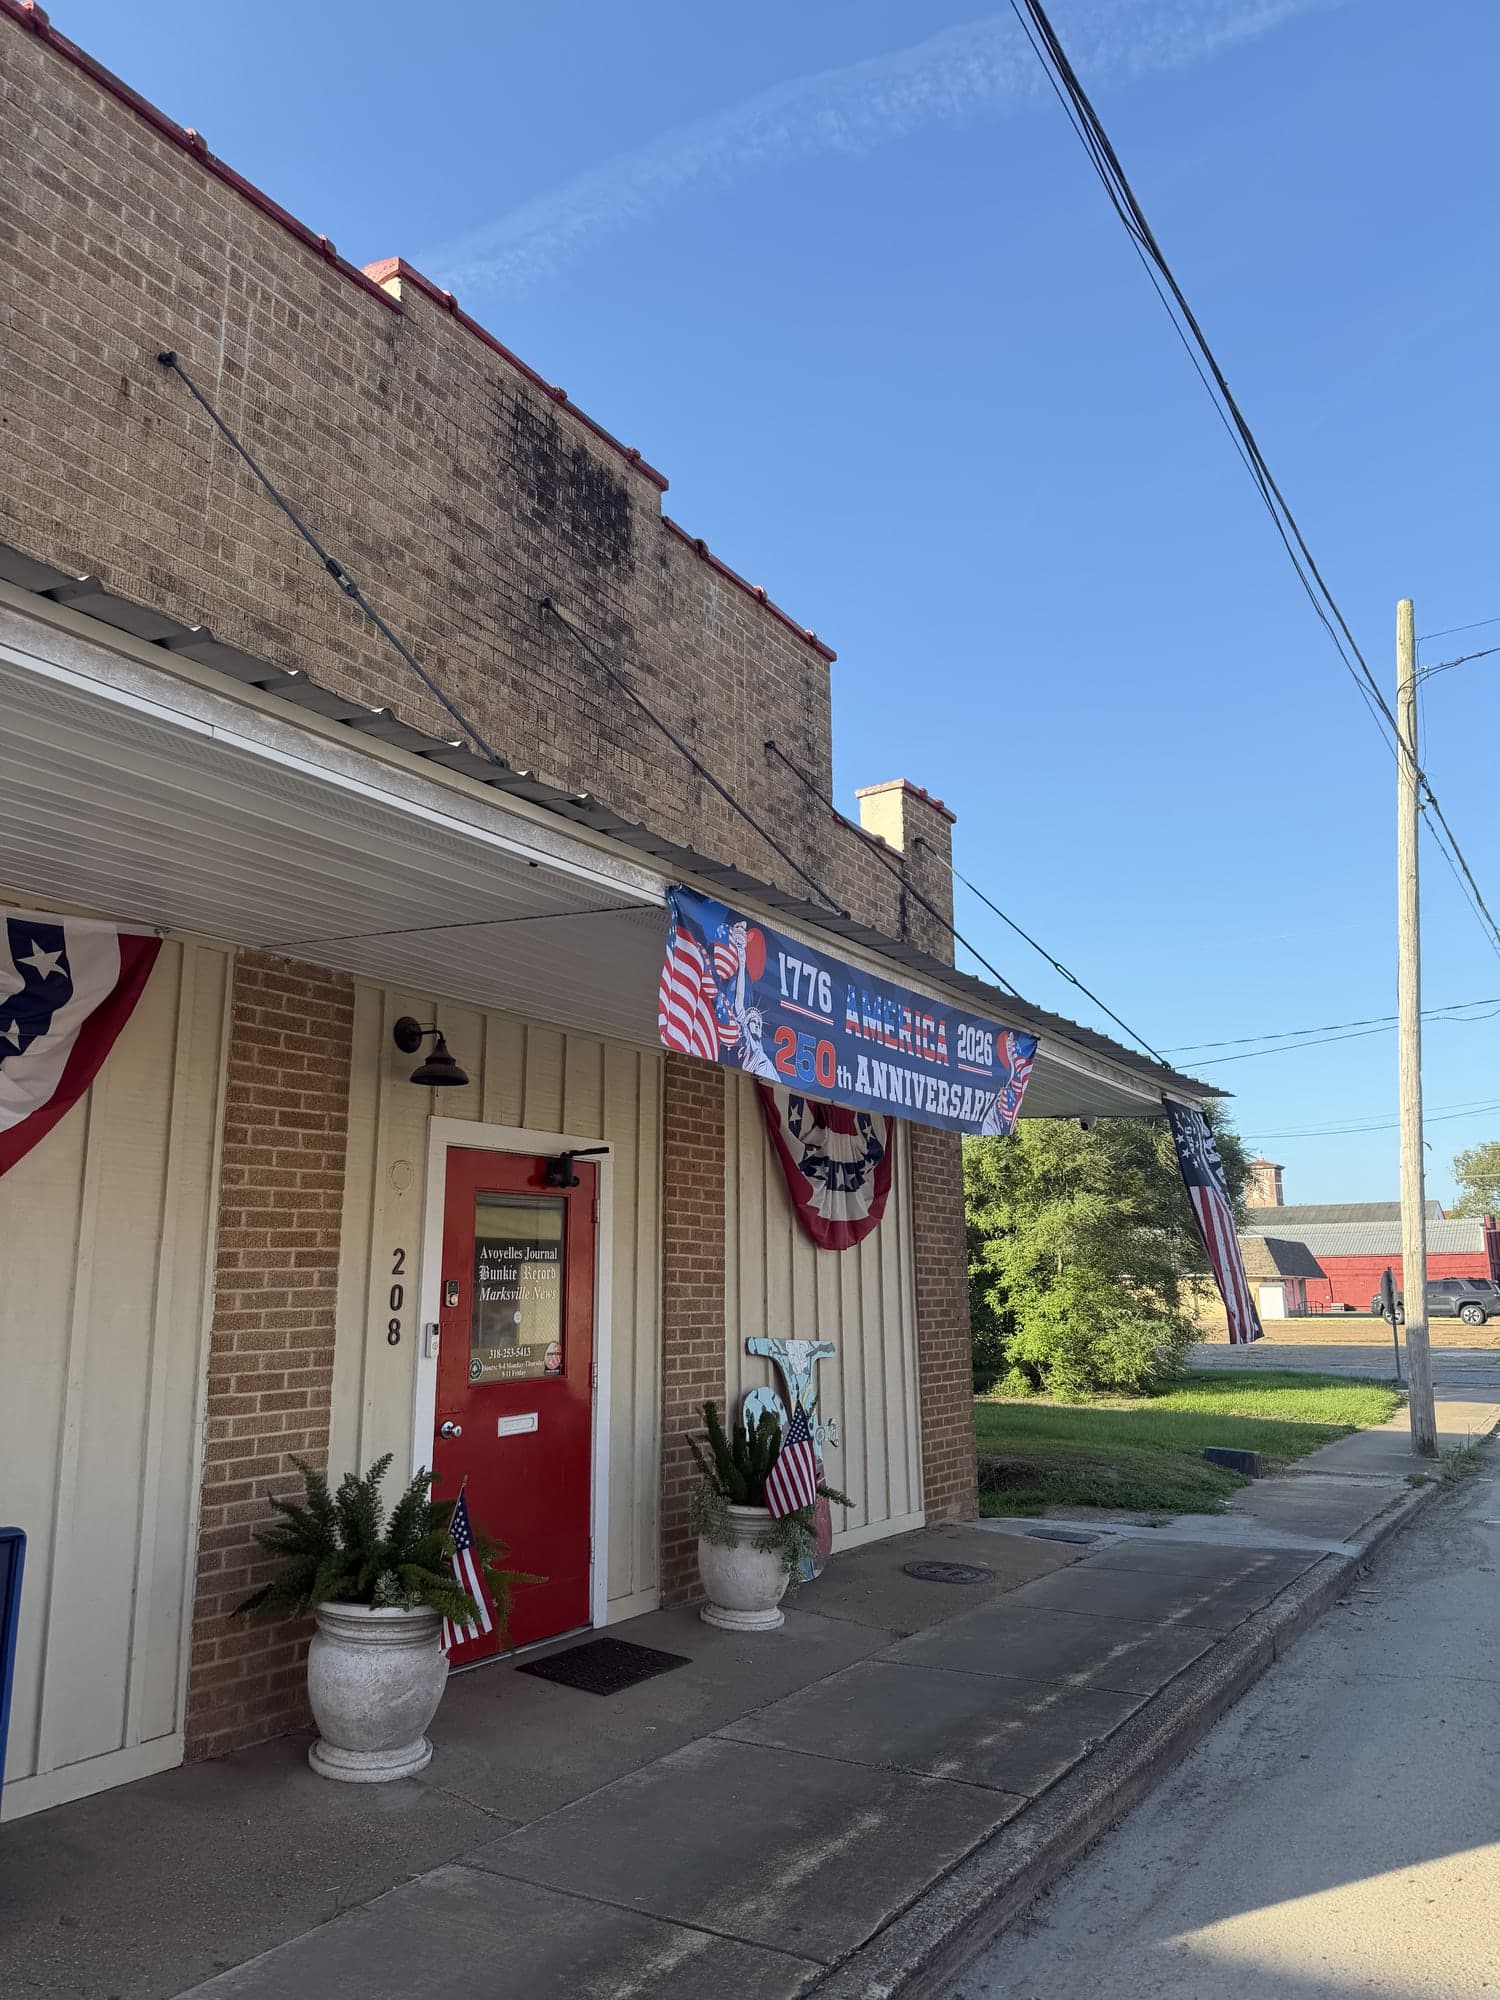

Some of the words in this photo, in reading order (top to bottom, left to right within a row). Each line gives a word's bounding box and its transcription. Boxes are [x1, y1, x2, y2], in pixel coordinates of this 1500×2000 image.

[778, 951, 833, 1014] 1776
[845, 984, 950, 1067] AMERICA
[957, 1023, 993, 1066] 2026
[855, 1054, 996, 1122] ANNIVERSARY
[480, 1245, 523, 1262] Avoyelles
[524, 1246, 558, 1261] Journal
[478, 1265, 518, 1283] Bunkie
[523, 1265, 556, 1283] Record
[387, 1247, 406, 1345] 208
[480, 1286, 530, 1301] Marksville
[532, 1286, 557, 1301] News
[488, 1347, 531, 1360] 318-253-5413
